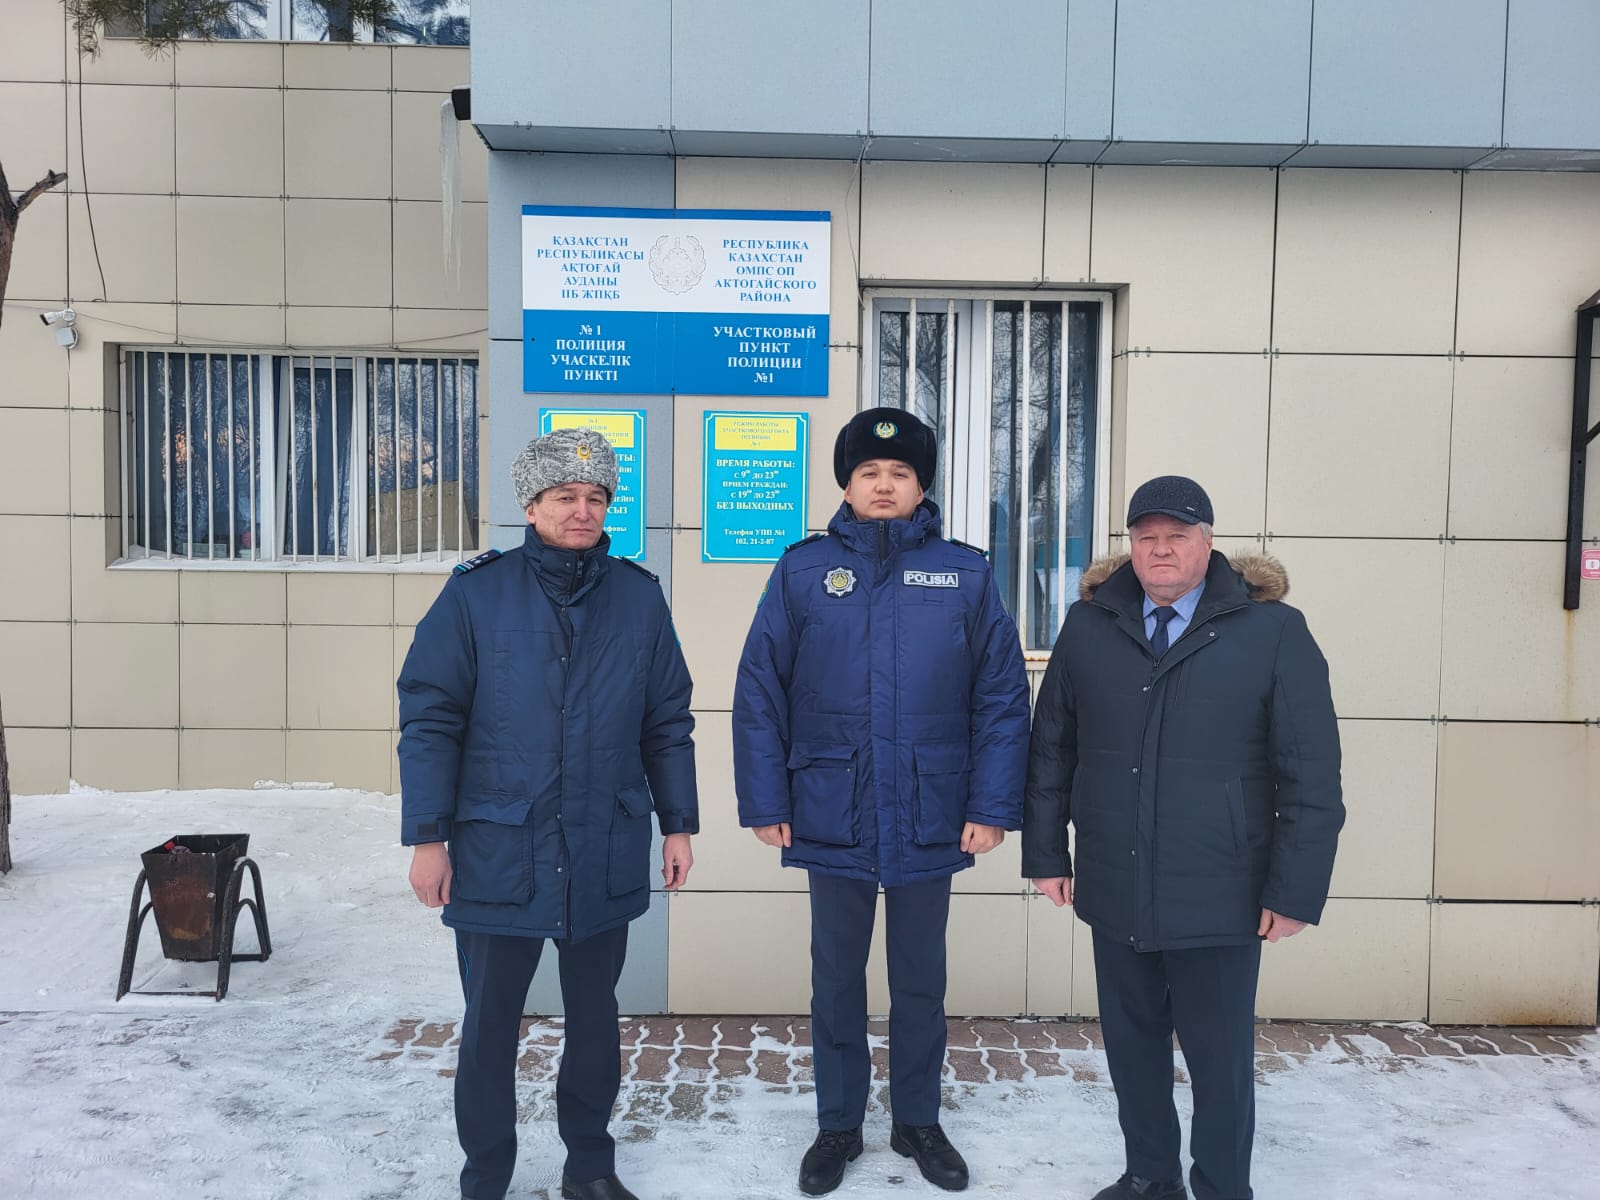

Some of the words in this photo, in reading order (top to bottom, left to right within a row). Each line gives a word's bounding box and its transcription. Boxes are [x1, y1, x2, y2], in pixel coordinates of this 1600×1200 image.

[552, 235, 628, 247] ҚАЗАҚСТАН
[723, 239, 809, 250] РЕСПУБЛИКА
[537, 248, 644, 261] РЕСПУБЛИКАСЫ
[728, 252, 803, 263] КАЗАХСТАН
[736, 265, 774, 276] ОМПС
[776, 266, 795, 276] ОП
[564, 276, 617, 287] АУДАНЫ
[714, 277, 817, 290] АКТОГАЙСКОГО
[740, 290, 791, 303] РАЙОНА
[579, 324, 593, 336] №
[596, 325, 601, 336] 1
[713, 325, 817, 339] УЧАСТКОВЫЙ
[556, 339, 626, 352] ПОЛИЦИЯ
[739, 341, 791, 354] ПУНКТ
[551, 354, 632, 367] УЧАСКЕЛІК
[727, 356, 802, 370] ПОЛИЦИИ
[564, 369, 618, 381] ПУНКТІ
[716, 459, 750, 468] ВРЕМЯ
[752, 460, 796, 469] РАБОТЫ:
[716, 501, 734, 510] БЕЗ
[736, 501, 794, 511] ВЫХОДНЫХ
[724, 528, 754, 537] Телефон
[906, 574, 956, 585] POLISIA
